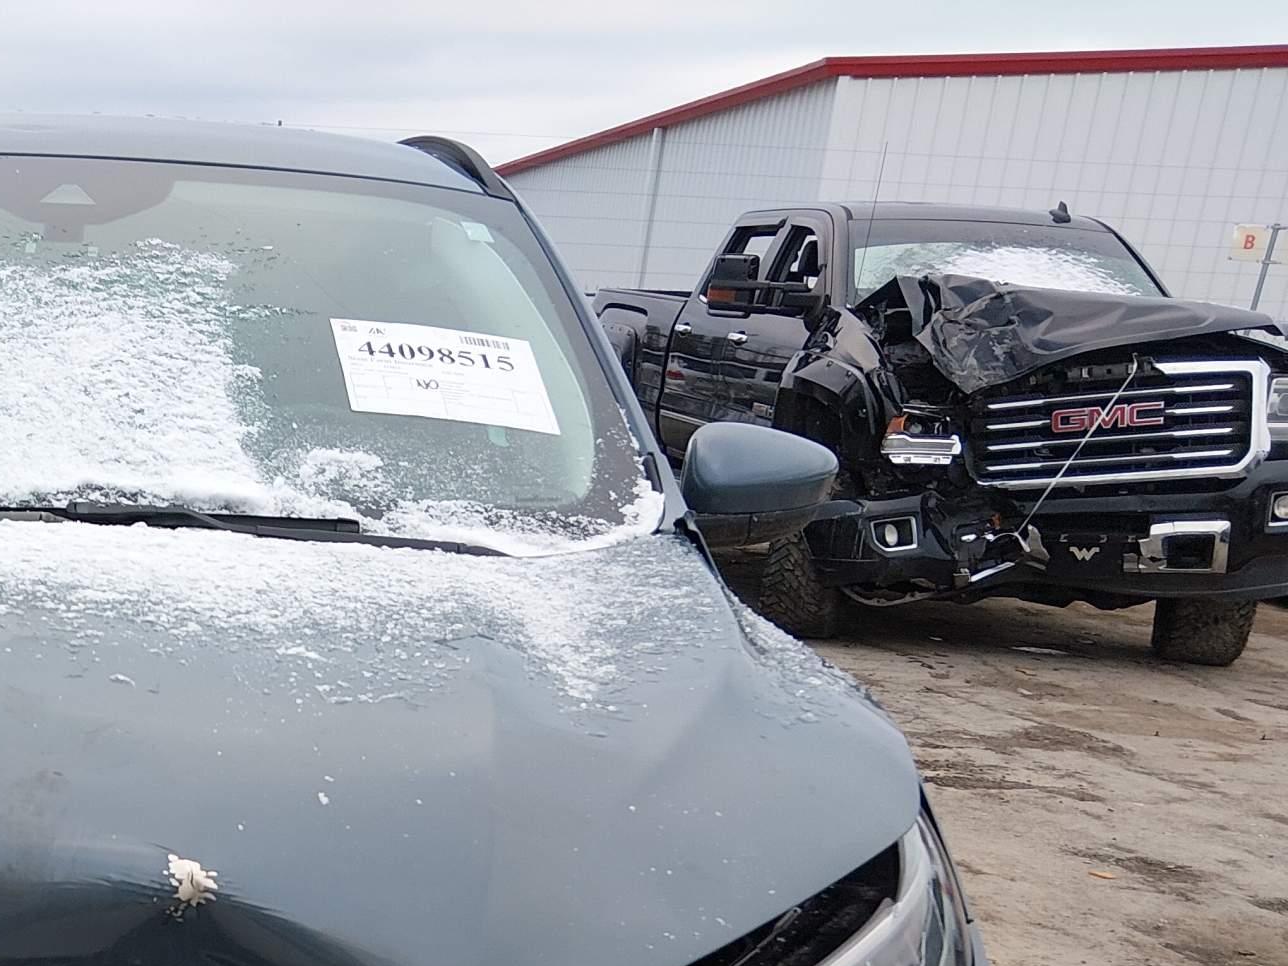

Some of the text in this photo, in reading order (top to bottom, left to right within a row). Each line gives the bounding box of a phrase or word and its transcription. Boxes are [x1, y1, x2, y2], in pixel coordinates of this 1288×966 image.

[1243, 234, 1256, 250] B
[357, 340, 515, 372] 44098515
[1052, 401, 1165, 433] GMC
